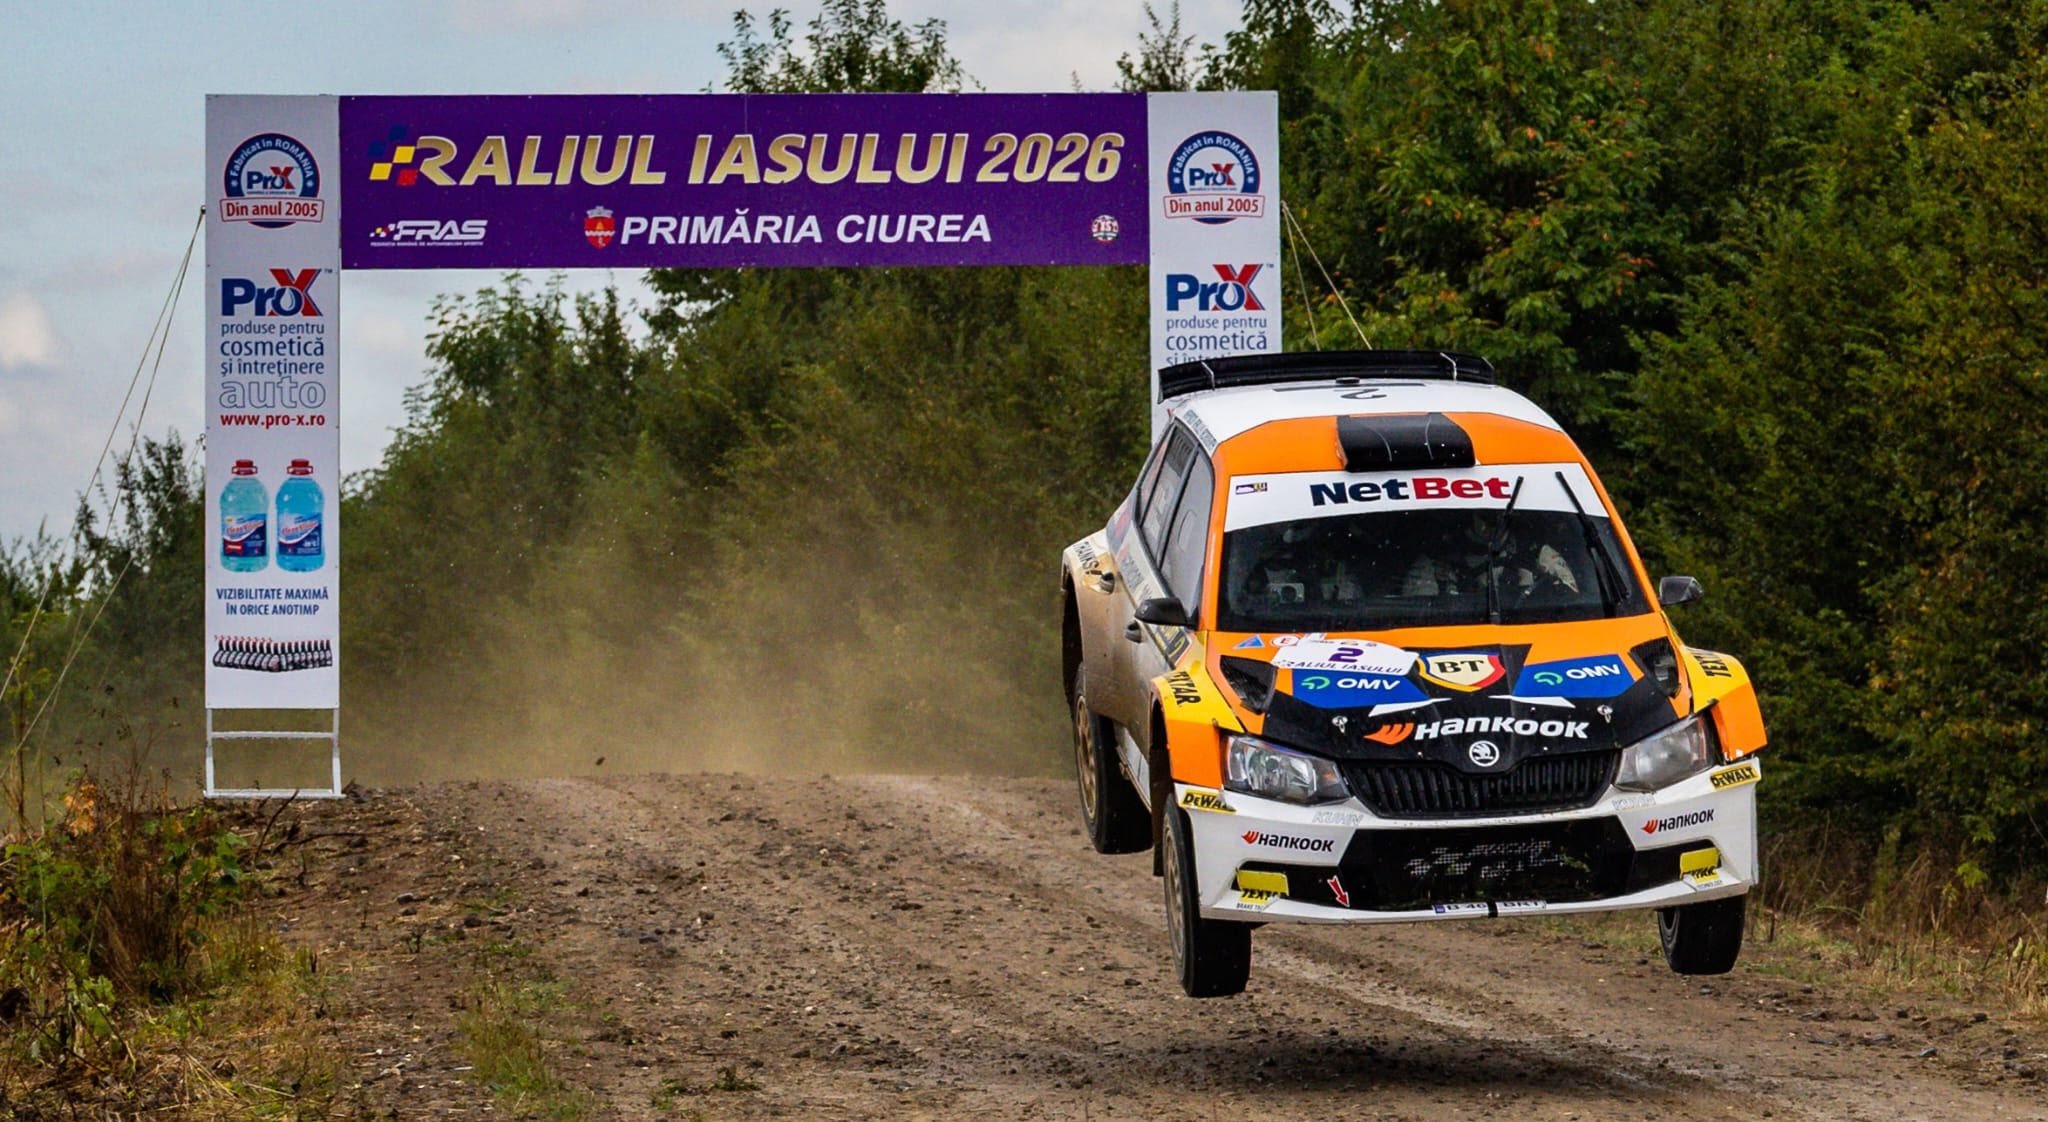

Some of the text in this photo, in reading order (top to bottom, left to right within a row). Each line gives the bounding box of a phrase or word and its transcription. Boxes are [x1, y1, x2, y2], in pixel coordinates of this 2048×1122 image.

[416, 132, 1125, 186] RALIUL IASULUI 2026
[226, 201, 318, 217] Din anul 2005
[1170, 198, 1259, 213] Din anul 2005
[393, 219, 488, 240] FRAS
[620, 208, 992, 244] PRIMĂRIA CIUREA
[221, 320, 325, 337] produse pentru
[1166, 315, 1267, 332] produse pentru
[220, 336, 325, 357] cosmetică
[1166, 330, 1267, 351] cosmetică
[219, 376, 326, 409] auto
[220, 414, 325, 429] www.pro-x.ro
[1309, 477, 1513, 506] NetBet
[216, 586, 328, 600] VIZIBILITATE MAXIMĂ
[226, 603, 320, 616] ÎN ORICE ANOTIMP
[1328, 647, 1364, 663] 2
[1436, 659, 1485, 674] BT
[1566, 663, 1622, 681] OMV
[1336, 677, 1401, 690] OMV
